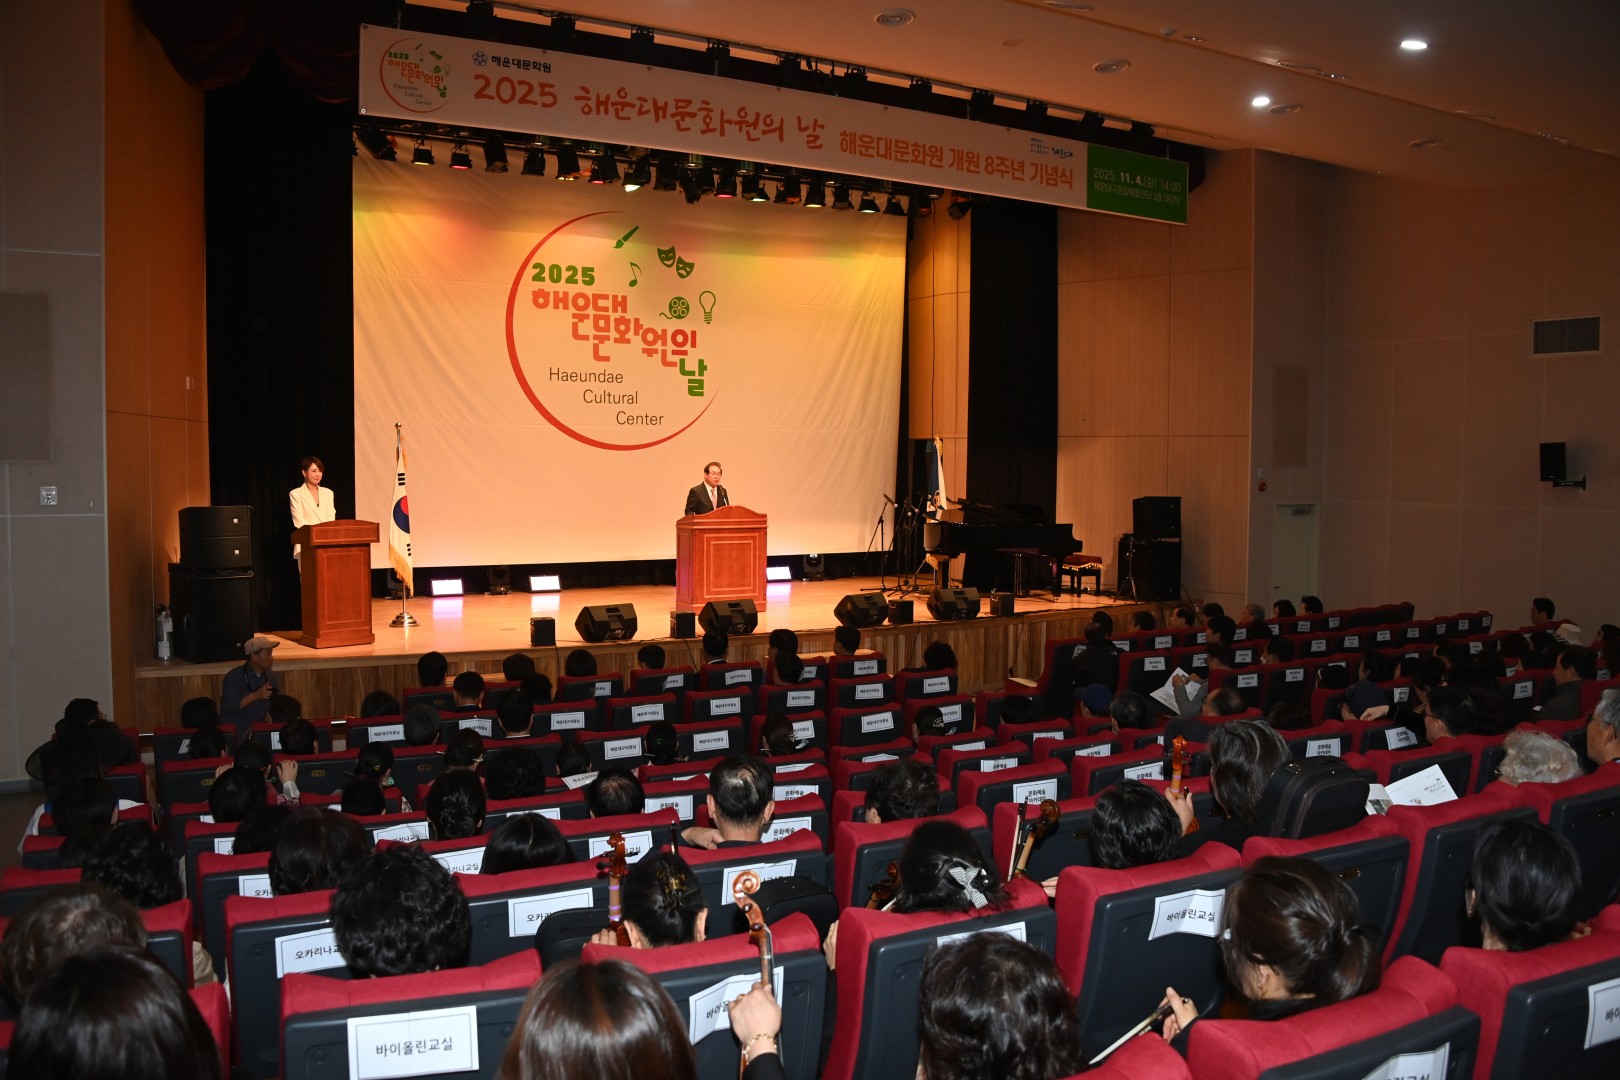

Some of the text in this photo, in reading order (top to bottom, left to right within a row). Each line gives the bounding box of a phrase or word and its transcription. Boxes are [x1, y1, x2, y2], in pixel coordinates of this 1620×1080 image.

[388, 51, 409, 60] 2025
[491, 55, 552, 73] 해운대문화원
[473, 74, 825, 149] 2025 해운대문화원의 날
[840, 130, 1073, 190] 해운대문화원 개원 8주년 기념식
[1093, 167, 1117, 181] 2025.
[1160, 179, 1181, 193] 14:00
[531, 263, 596, 286] 2025
[549, 367, 624, 384] Haeundae
[679, 358, 708, 397] 날
[583, 389, 638, 405] Cultural
[616, 411, 664, 426] Center
[1136, 771, 1153, 779] 문화예술
[1028, 788, 1046, 797] 문화예술
[773, 827, 795, 836] 문화예술
[1166, 908, 1216, 923] 바이올린교실
[295, 944, 342, 960] 오카리나교
[376, 1036, 453, 1057] 바이올린교실
